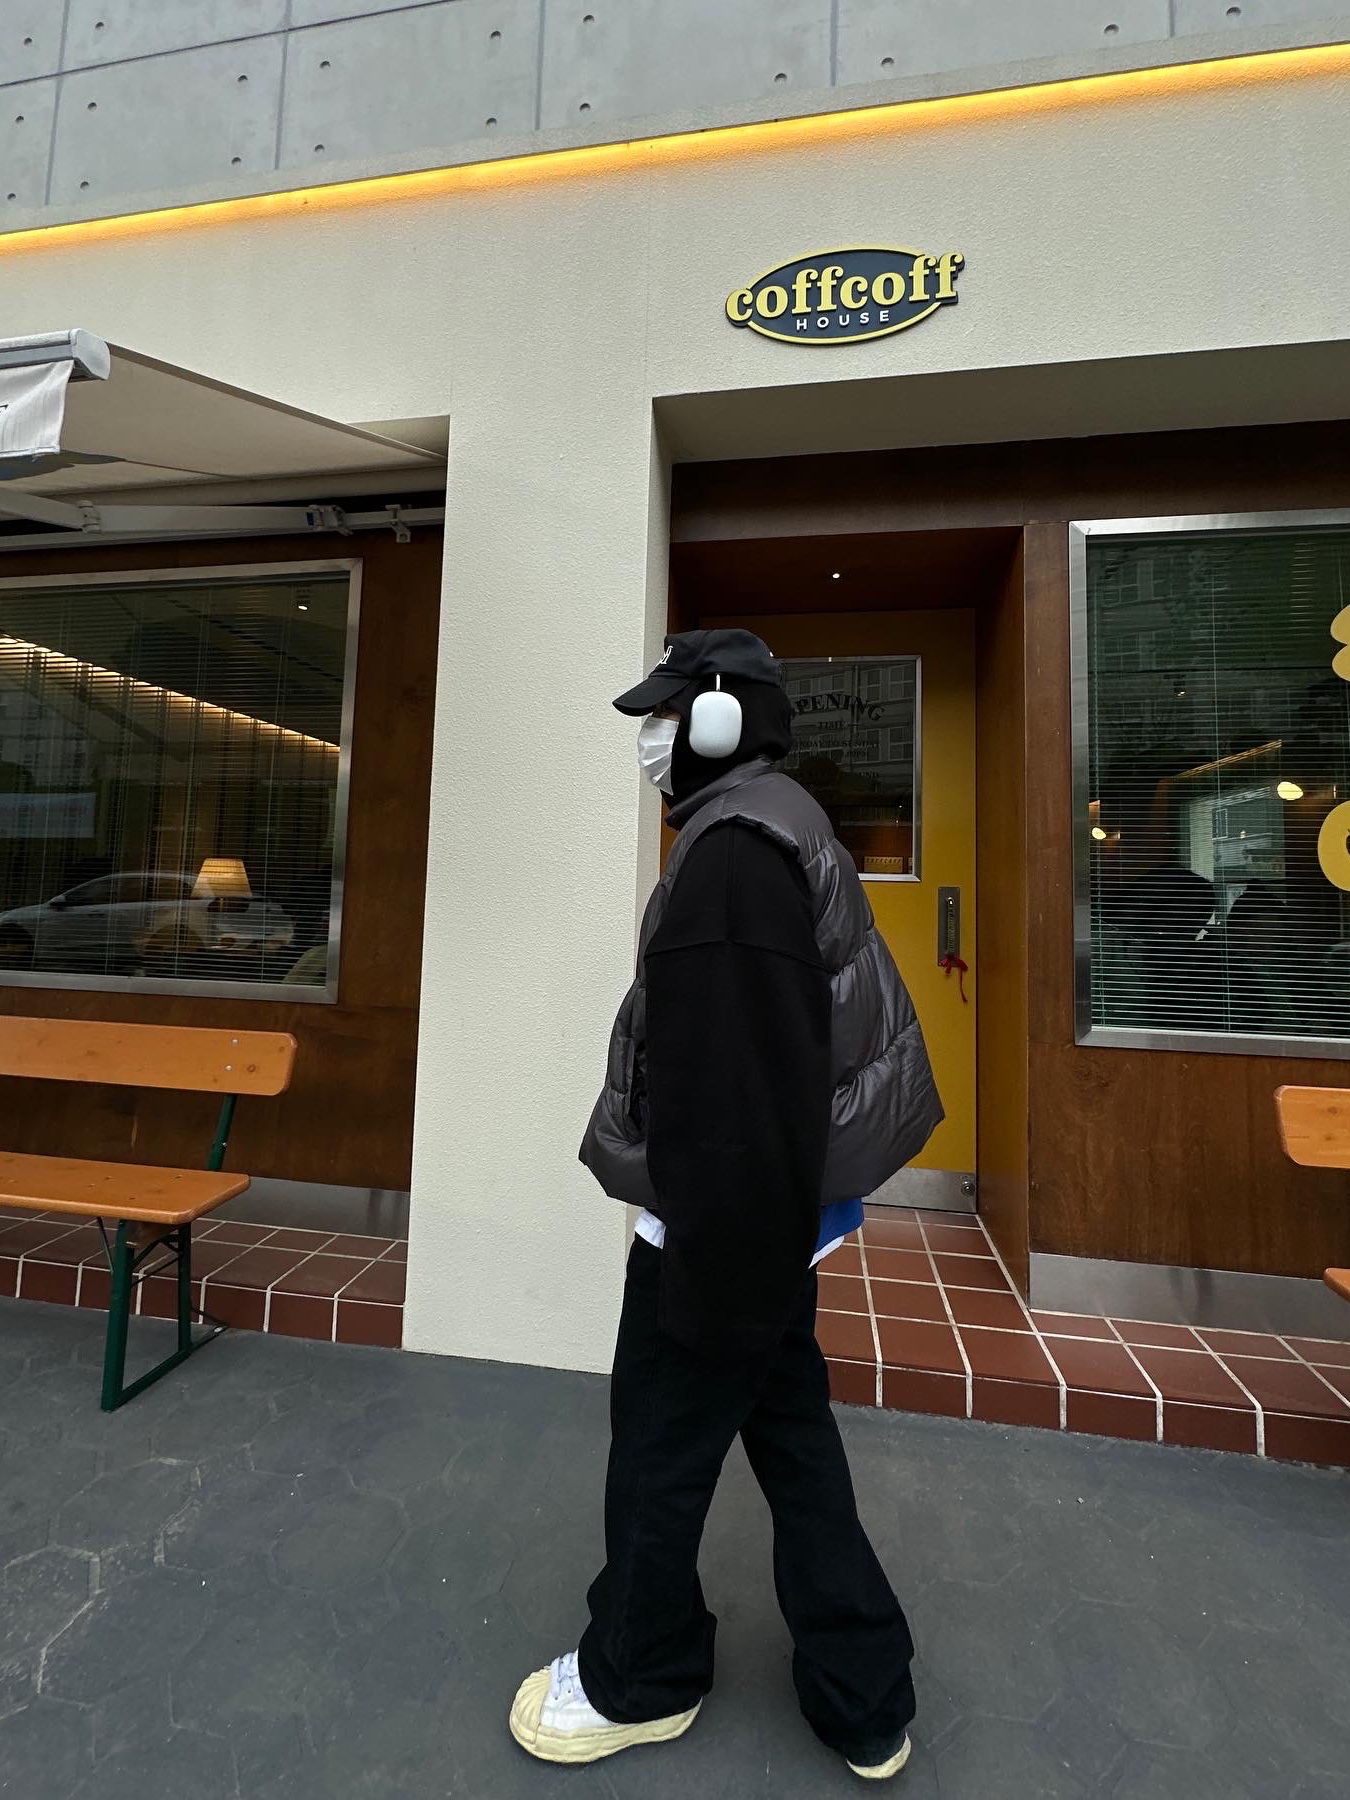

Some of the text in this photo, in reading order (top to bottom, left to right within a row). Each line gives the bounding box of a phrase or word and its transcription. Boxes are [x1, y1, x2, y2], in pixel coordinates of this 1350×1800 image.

[726, 252, 963, 321] coffcoff
[796, 310, 890, 330] HOUSE
[792, 694, 884, 721] PENING
